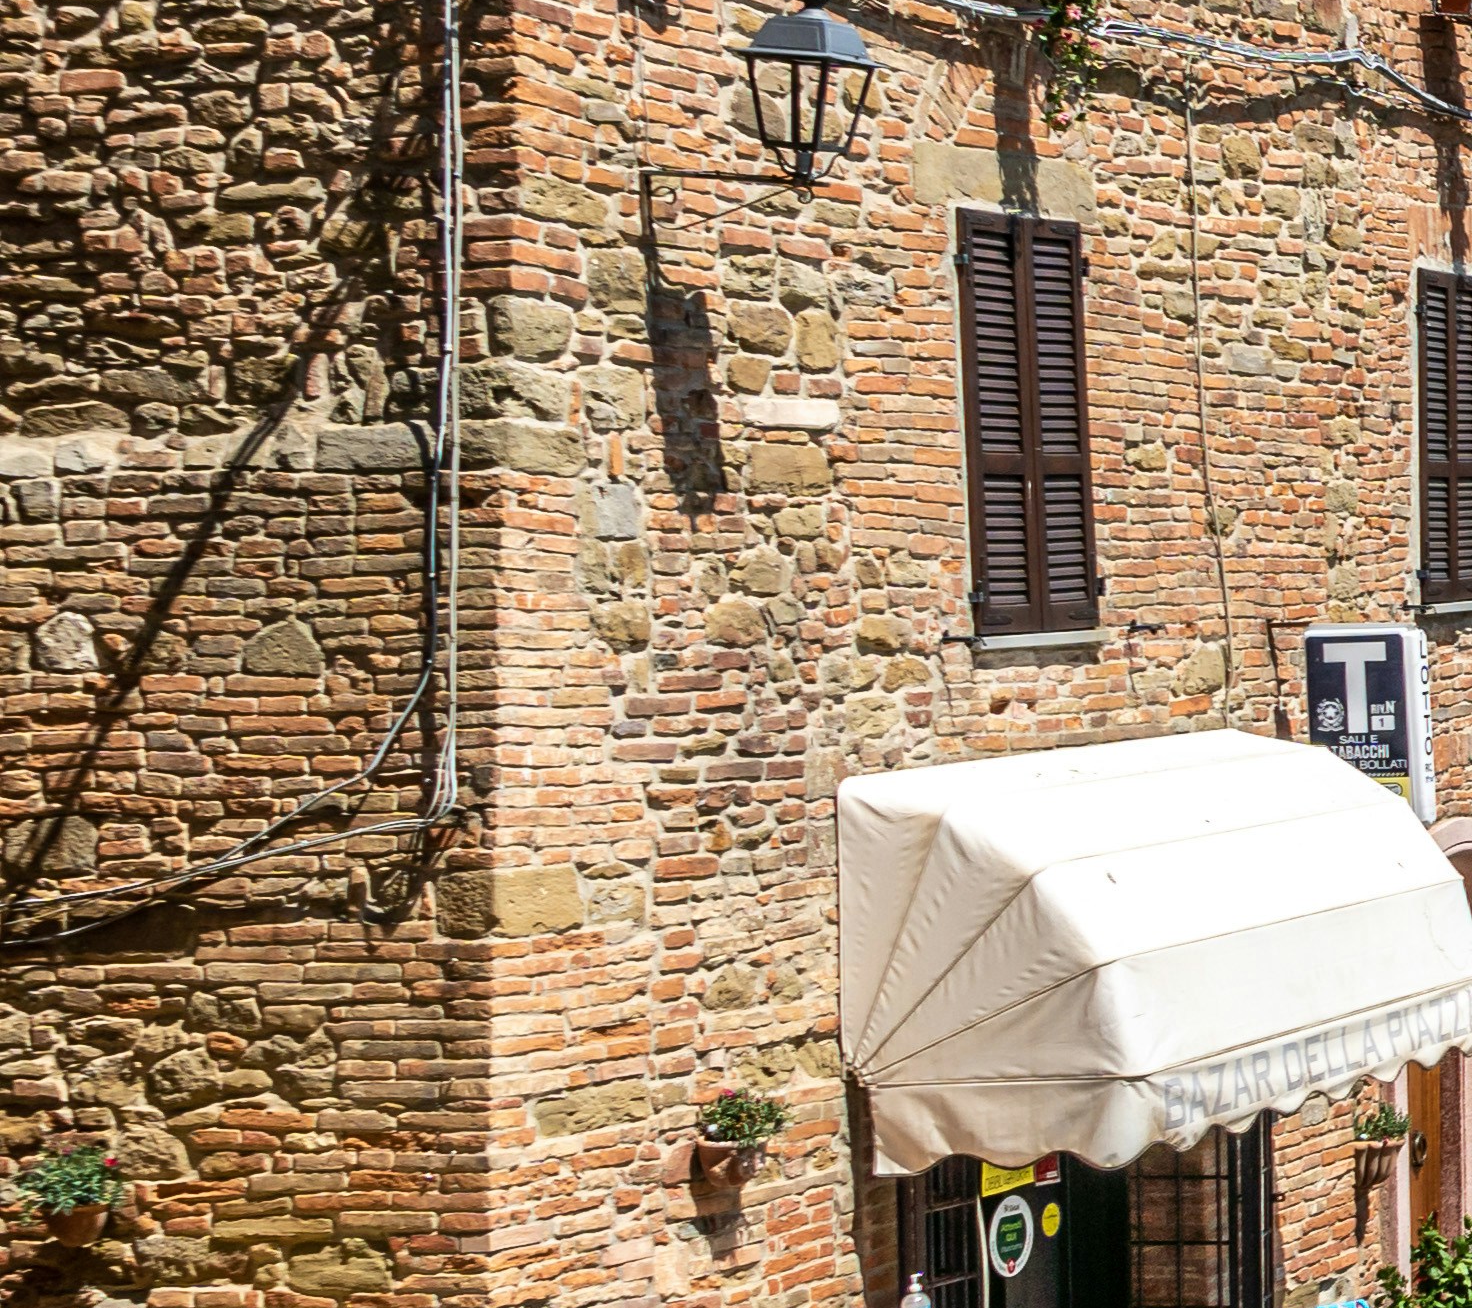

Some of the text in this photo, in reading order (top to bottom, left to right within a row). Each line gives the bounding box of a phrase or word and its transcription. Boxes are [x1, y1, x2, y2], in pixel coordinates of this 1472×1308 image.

[1419, 632, 1433, 756] LOTTO
[1379, 718, 1384, 727] 1
[1339, 734, 1378, 744] SALI E
[1331, 744, 1389, 760] TABACCHI
[1360, 758, 1407, 770] BOLLATI
[1164, 1049, 1275, 1130] BAZAR
[1282, 1019, 1383, 1090] DELLA
